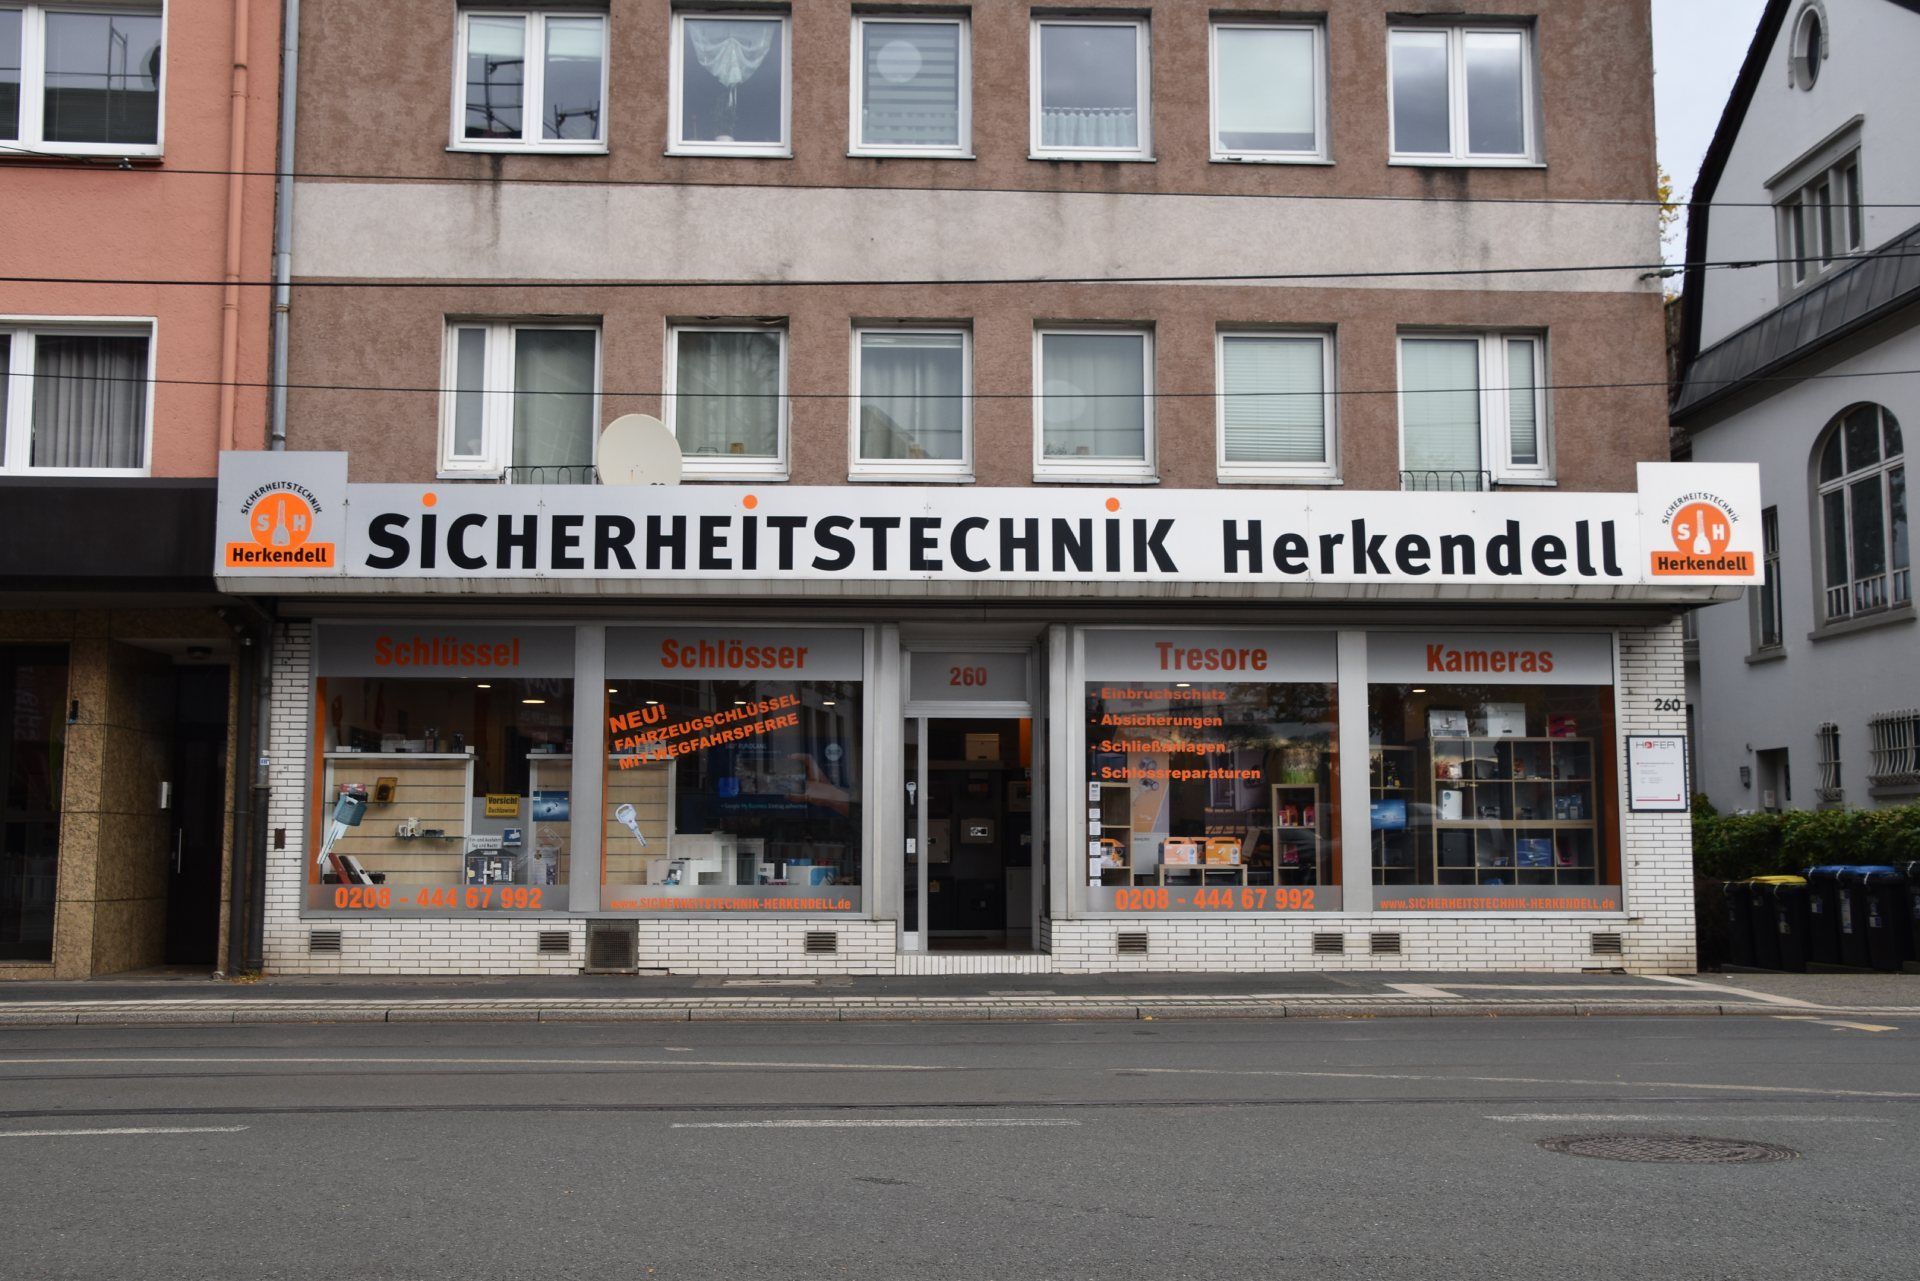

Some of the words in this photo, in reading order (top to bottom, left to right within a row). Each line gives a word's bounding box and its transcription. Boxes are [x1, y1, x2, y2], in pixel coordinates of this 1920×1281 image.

[241, 481, 322, 515] SICHERHEITSTECHNIK
[1662, 492, 1739, 525] SICHERHEITSTECHNIK
[233, 547, 326, 562] Herkendell
[1223, 518, 1623, 577] Herkendell
[1658, 556, 1748, 571] Herkendell
[374, 636, 519, 667] Schlüssel
[660, 638, 809, 670] Schlösser
[1155, 642, 1268, 671] Tresore
[1426, 644, 1554, 673] Kameras
[949, 666, 988, 687] 260
[1101, 688, 1226, 700] Einbruchschutz
[1654, 698, 1681, 712] 260
[609, 704, 667, 734] NEU!
[614, 694, 801, 752] FAHRZEUGSCHLÜSSEL
[1101, 715, 1223, 730] Absicherungen
[618, 753, 648, 771] MIT
[652, 713, 800, 761] WEGFAHRSPERRE
[1101, 740, 1226, 756] Schließanlagen
[1101, 767, 1261, 781] Schlossreparaturen
[335, 887, 391, 909] 0208
[416, 887, 457, 909] 444
[465, 887, 492, 909] 67
[501, 887, 543, 909] 992
[1115, 888, 1170, 910] 0208
[1193, 888, 1234, 910] 444
[1241, 888, 1267, 910] 67
[1275, 888, 1315, 910] 992
